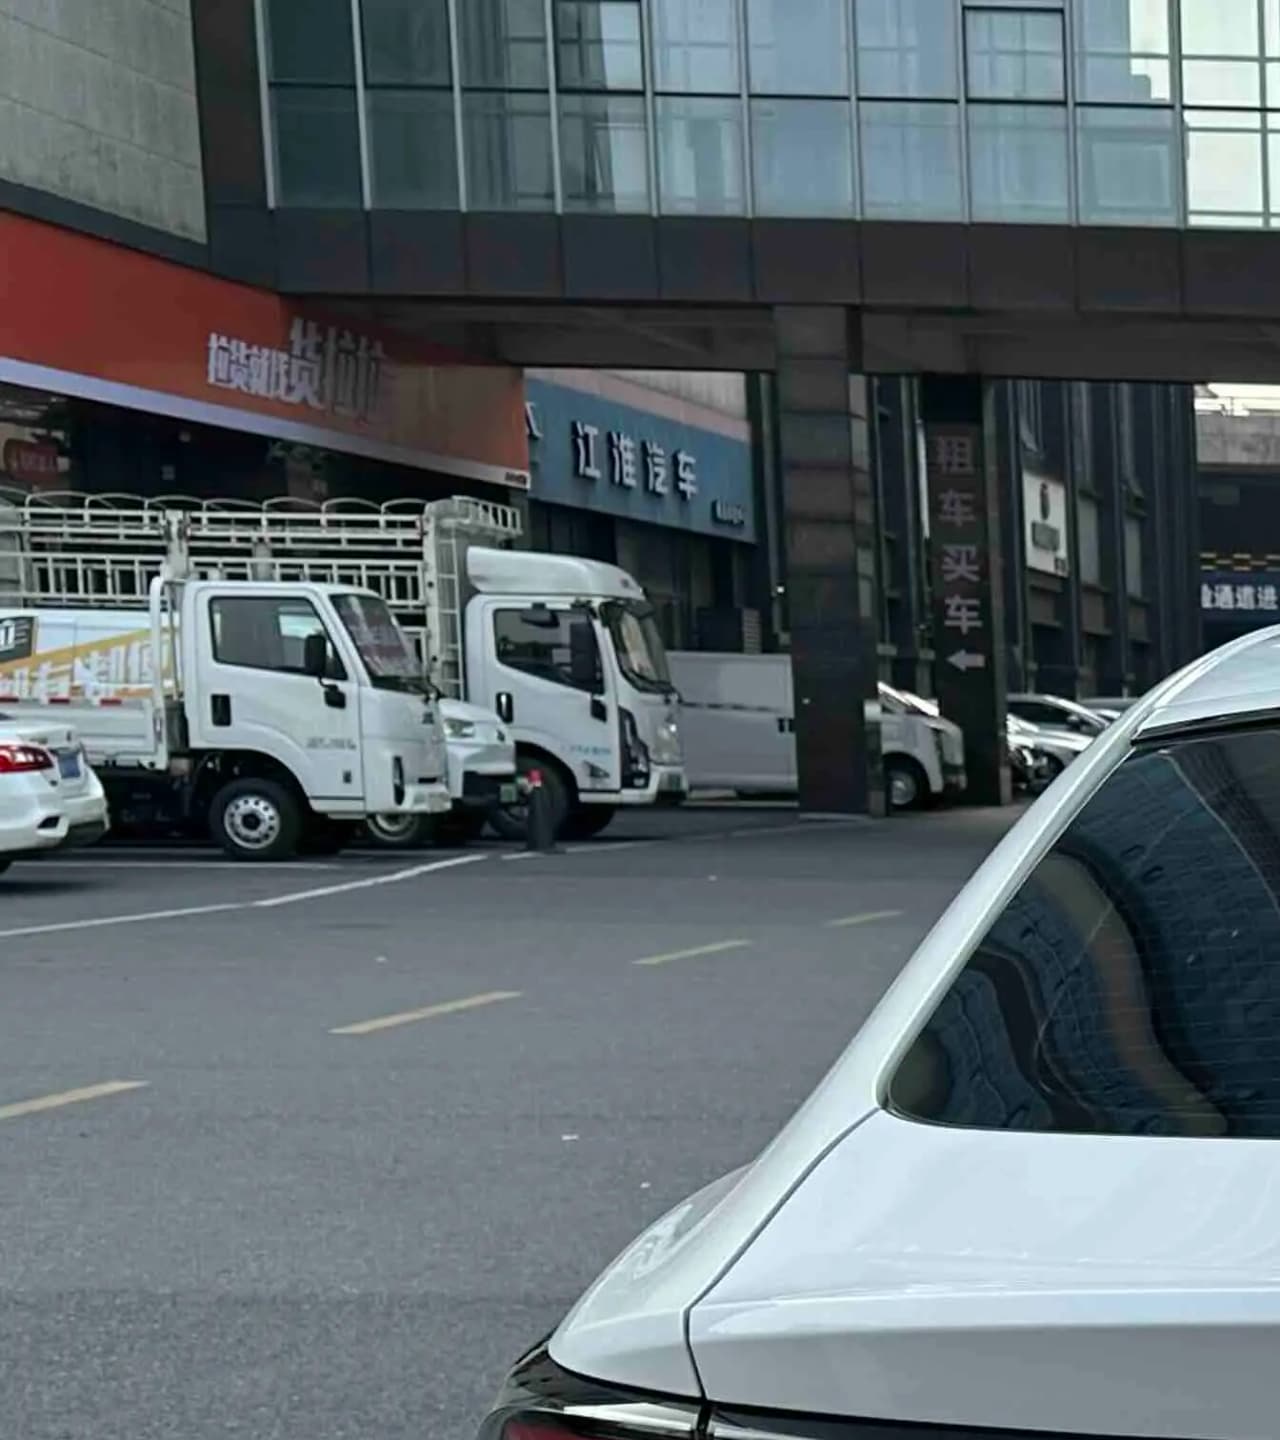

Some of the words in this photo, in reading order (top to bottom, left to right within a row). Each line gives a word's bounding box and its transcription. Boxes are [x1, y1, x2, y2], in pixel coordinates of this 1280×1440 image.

[573, 420, 699, 500] 江淮汽车
[936, 434, 983, 636] 租车买车
